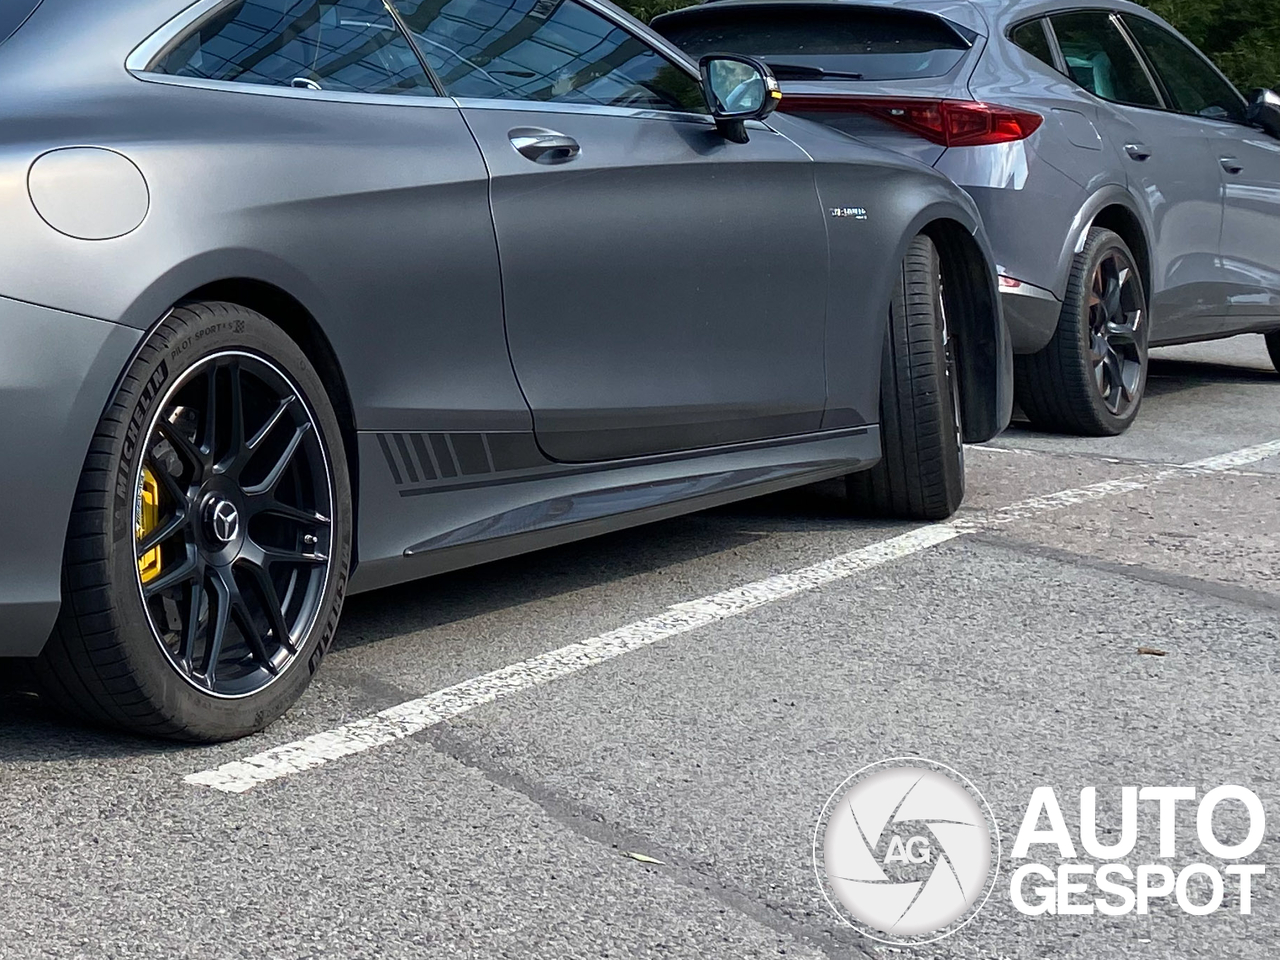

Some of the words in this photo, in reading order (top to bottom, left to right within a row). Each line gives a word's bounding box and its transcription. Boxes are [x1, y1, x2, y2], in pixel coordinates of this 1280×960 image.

[171, 337, 192, 360] PILOT
[195, 323, 221, 340] SPORT
[117, 361, 167, 503] MICHELIN
